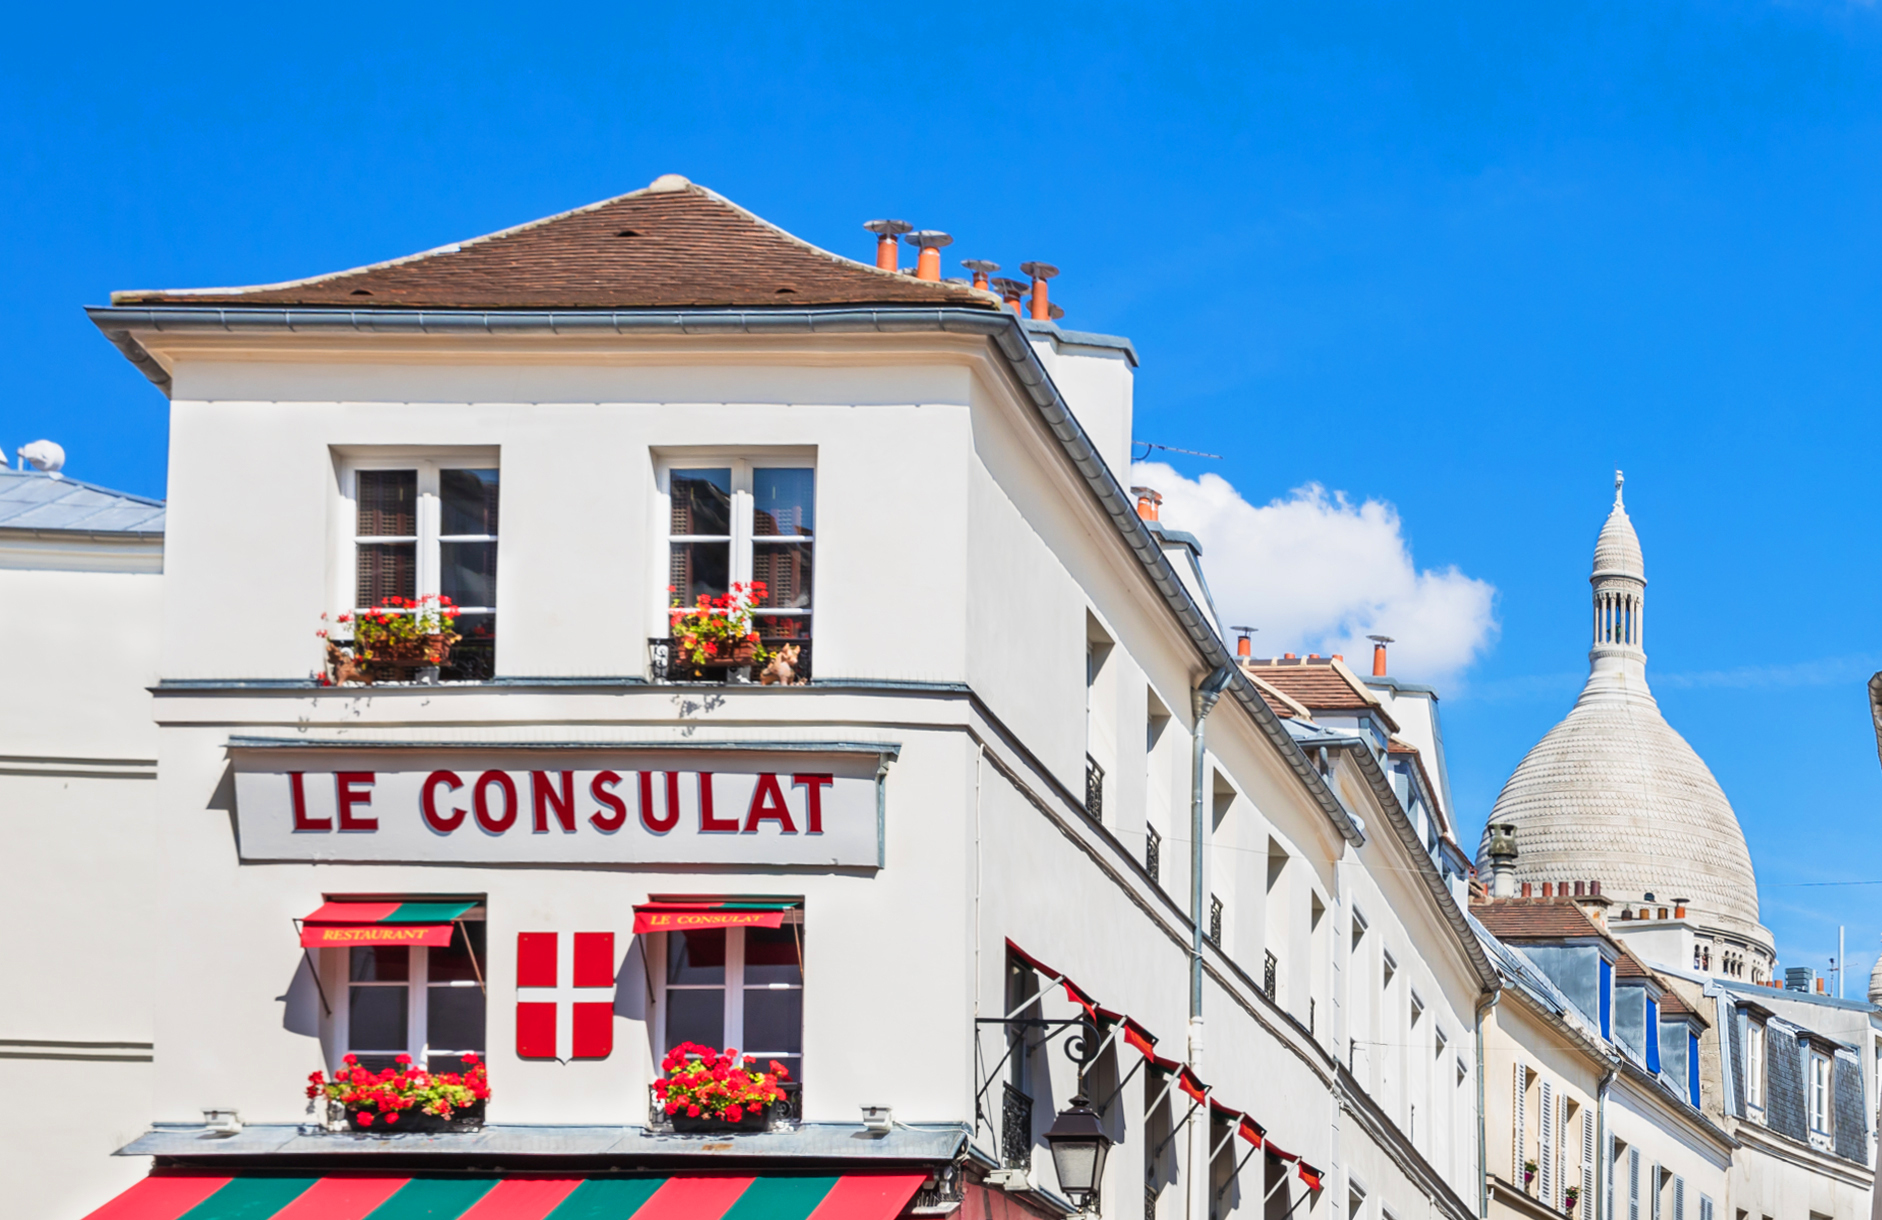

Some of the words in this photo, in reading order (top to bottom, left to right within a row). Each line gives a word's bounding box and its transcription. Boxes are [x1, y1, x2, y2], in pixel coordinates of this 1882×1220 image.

[289, 770, 379, 832] LE
[420, 769, 834, 835] CONSULAT
[650, 915, 671, 926] LE
[677, 914, 764, 925] CONSULAT
[322, 929, 428, 941] RESTAURANT
